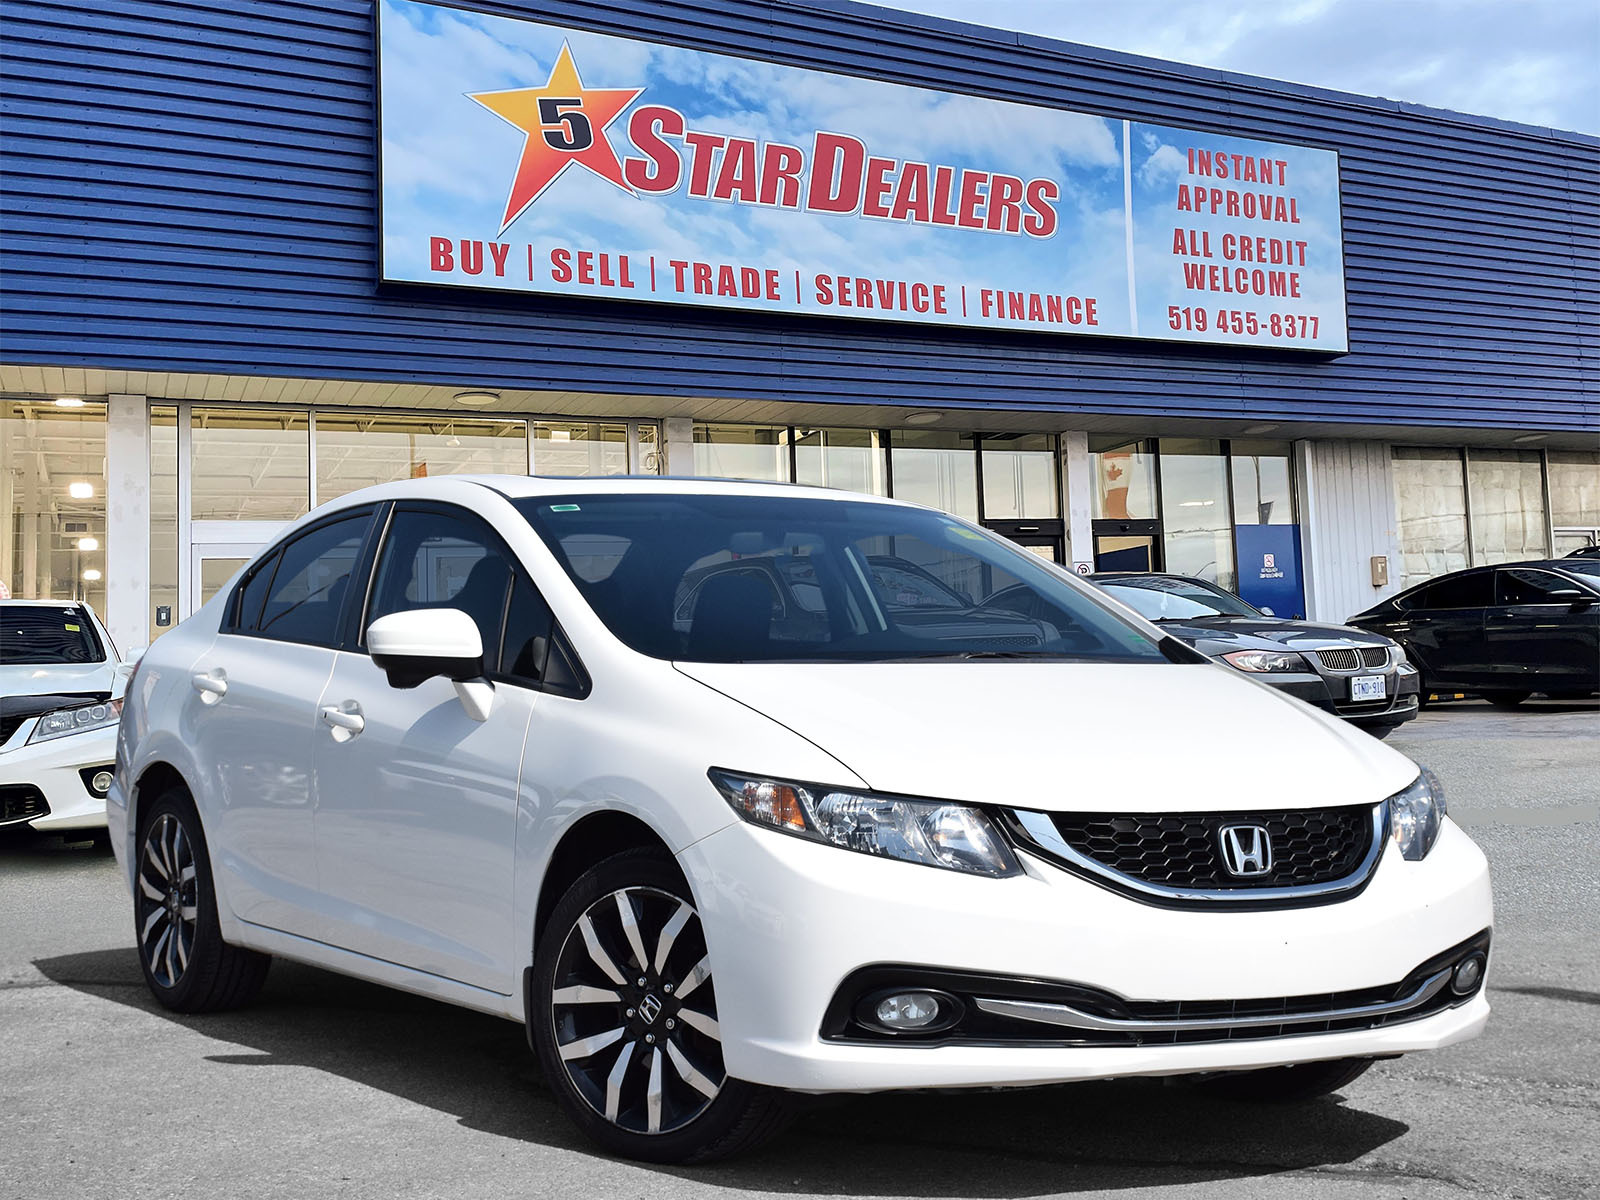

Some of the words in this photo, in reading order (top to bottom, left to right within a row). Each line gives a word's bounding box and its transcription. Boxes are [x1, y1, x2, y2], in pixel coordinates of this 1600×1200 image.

[536, 97, 592, 150] 5
[1187, 147, 1288, 187] INSTANT
[1177, 184, 1301, 224] APPROVAL
[1173, 227, 1213, 258] ALL
[1223, 232, 1308, 267] CREDIT
[430, 236, 510, 277] BUY
[550, 248, 635, 289] SELL
[669, 260, 781, 301] TRADE
[815, 274, 948, 314] SERVICE
[980, 289, 1098, 326] FINANCE
[1183, 263, 1301, 298] WELCOME
[1168, 306, 1208, 332] 519
[1216, 309, 1320, 340] 455-8377
